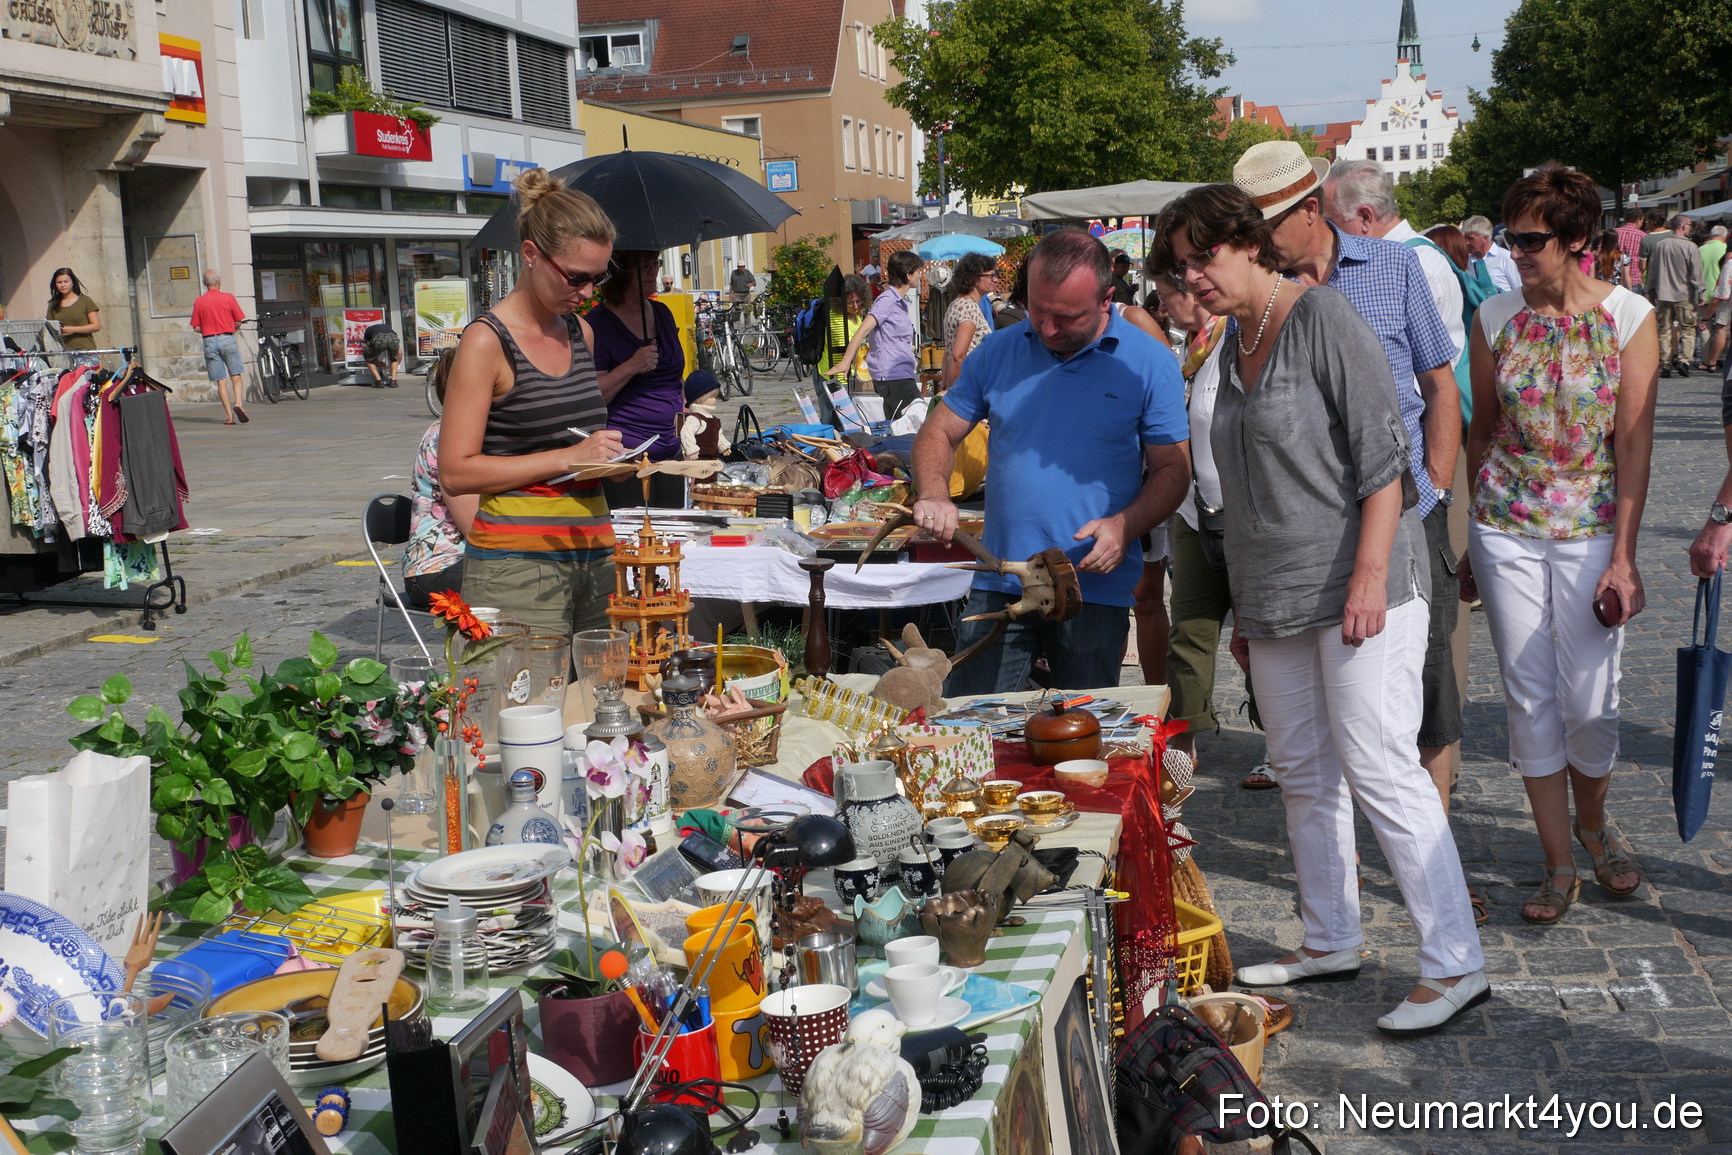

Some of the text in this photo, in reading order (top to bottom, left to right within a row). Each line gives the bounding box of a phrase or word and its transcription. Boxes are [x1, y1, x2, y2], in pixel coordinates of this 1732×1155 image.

[376, 128, 409, 145] Studienkreis
[883, 819, 907, 831] TRINKT
[868, 829, 906, 841] GOLDENEN
[869, 841, 883, 849] AUS
[885, 836, 907, 846] EINEM
[882, 846, 897, 854] VON
